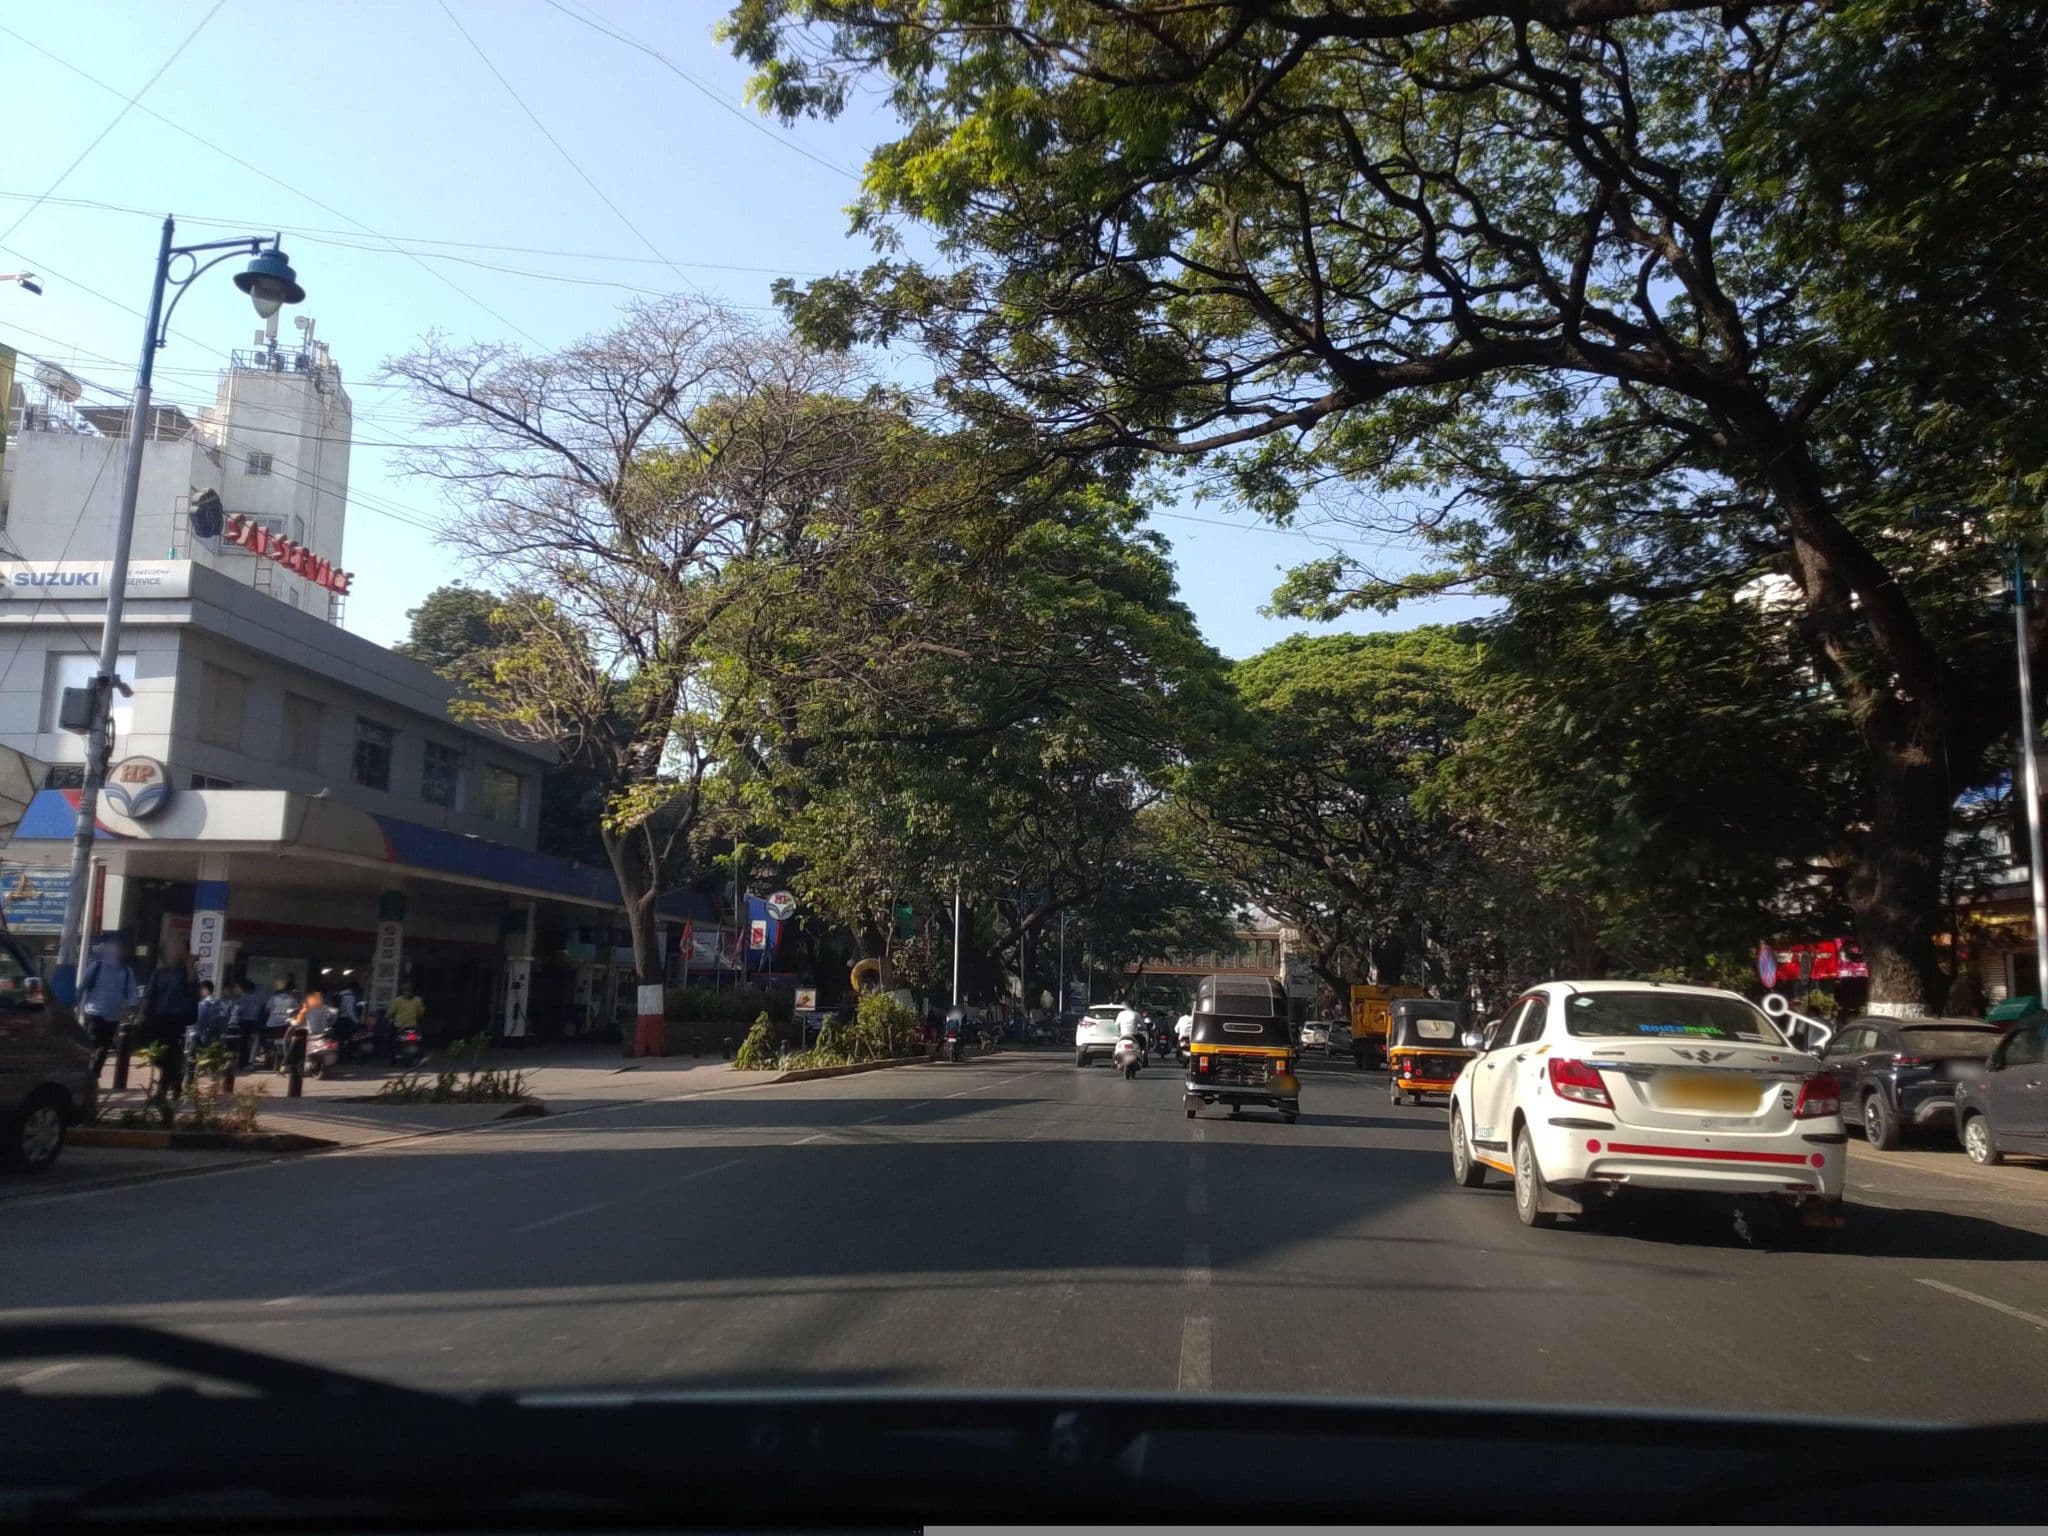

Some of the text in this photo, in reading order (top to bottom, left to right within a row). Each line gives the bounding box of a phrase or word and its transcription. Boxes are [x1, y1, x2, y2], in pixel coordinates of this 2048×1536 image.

[223, 512, 355, 596] SAI SERVICE
[14, 571, 99, 587] SUZUKI
[119, 764, 156, 783] HP
